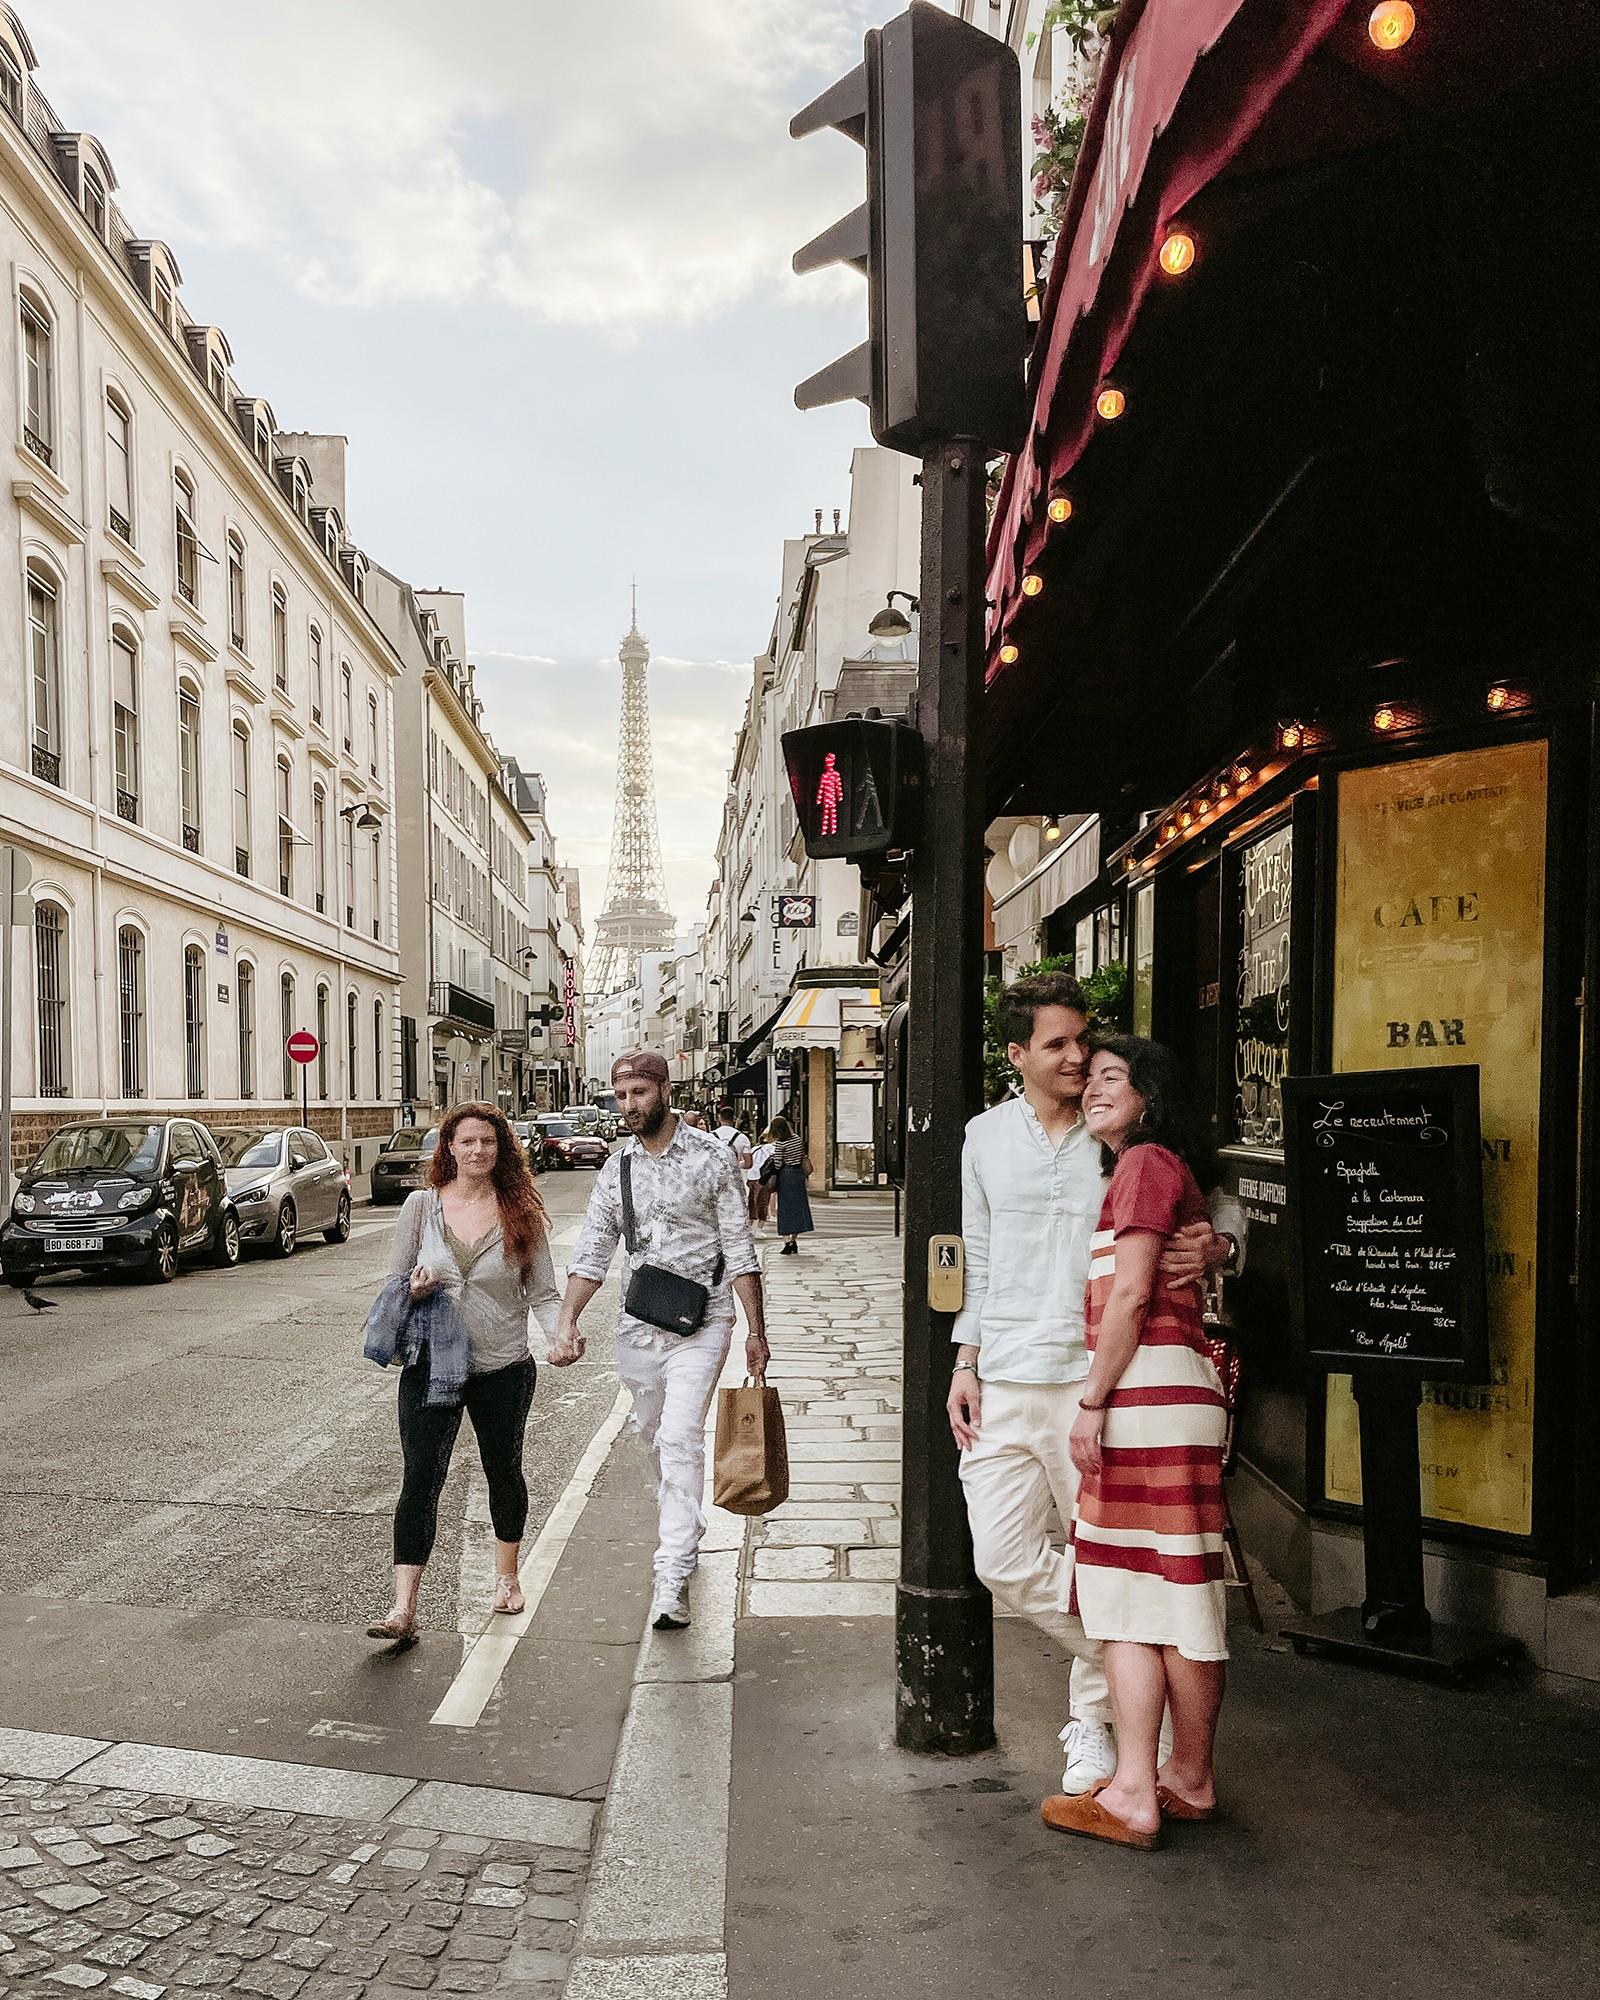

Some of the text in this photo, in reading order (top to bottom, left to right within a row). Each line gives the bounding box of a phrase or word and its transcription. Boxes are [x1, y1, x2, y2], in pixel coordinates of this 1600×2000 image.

[1247, 843, 1281, 917] CAFÉ
[1252, 949, 1277, 998] THÉ
[566, 959, 575, 1045] THOUMIEUX
[1386, 1018, 1467, 1048] BAR
[1235, 1037, 1290, 1088] CHOCOLA
[1312, 1101, 1433, 1130] Le recrutement
[1351, 1192, 1359, 1203] à
[1363, 1189, 1371, 1203] la
[1393, 1215, 1403, 1227] du
